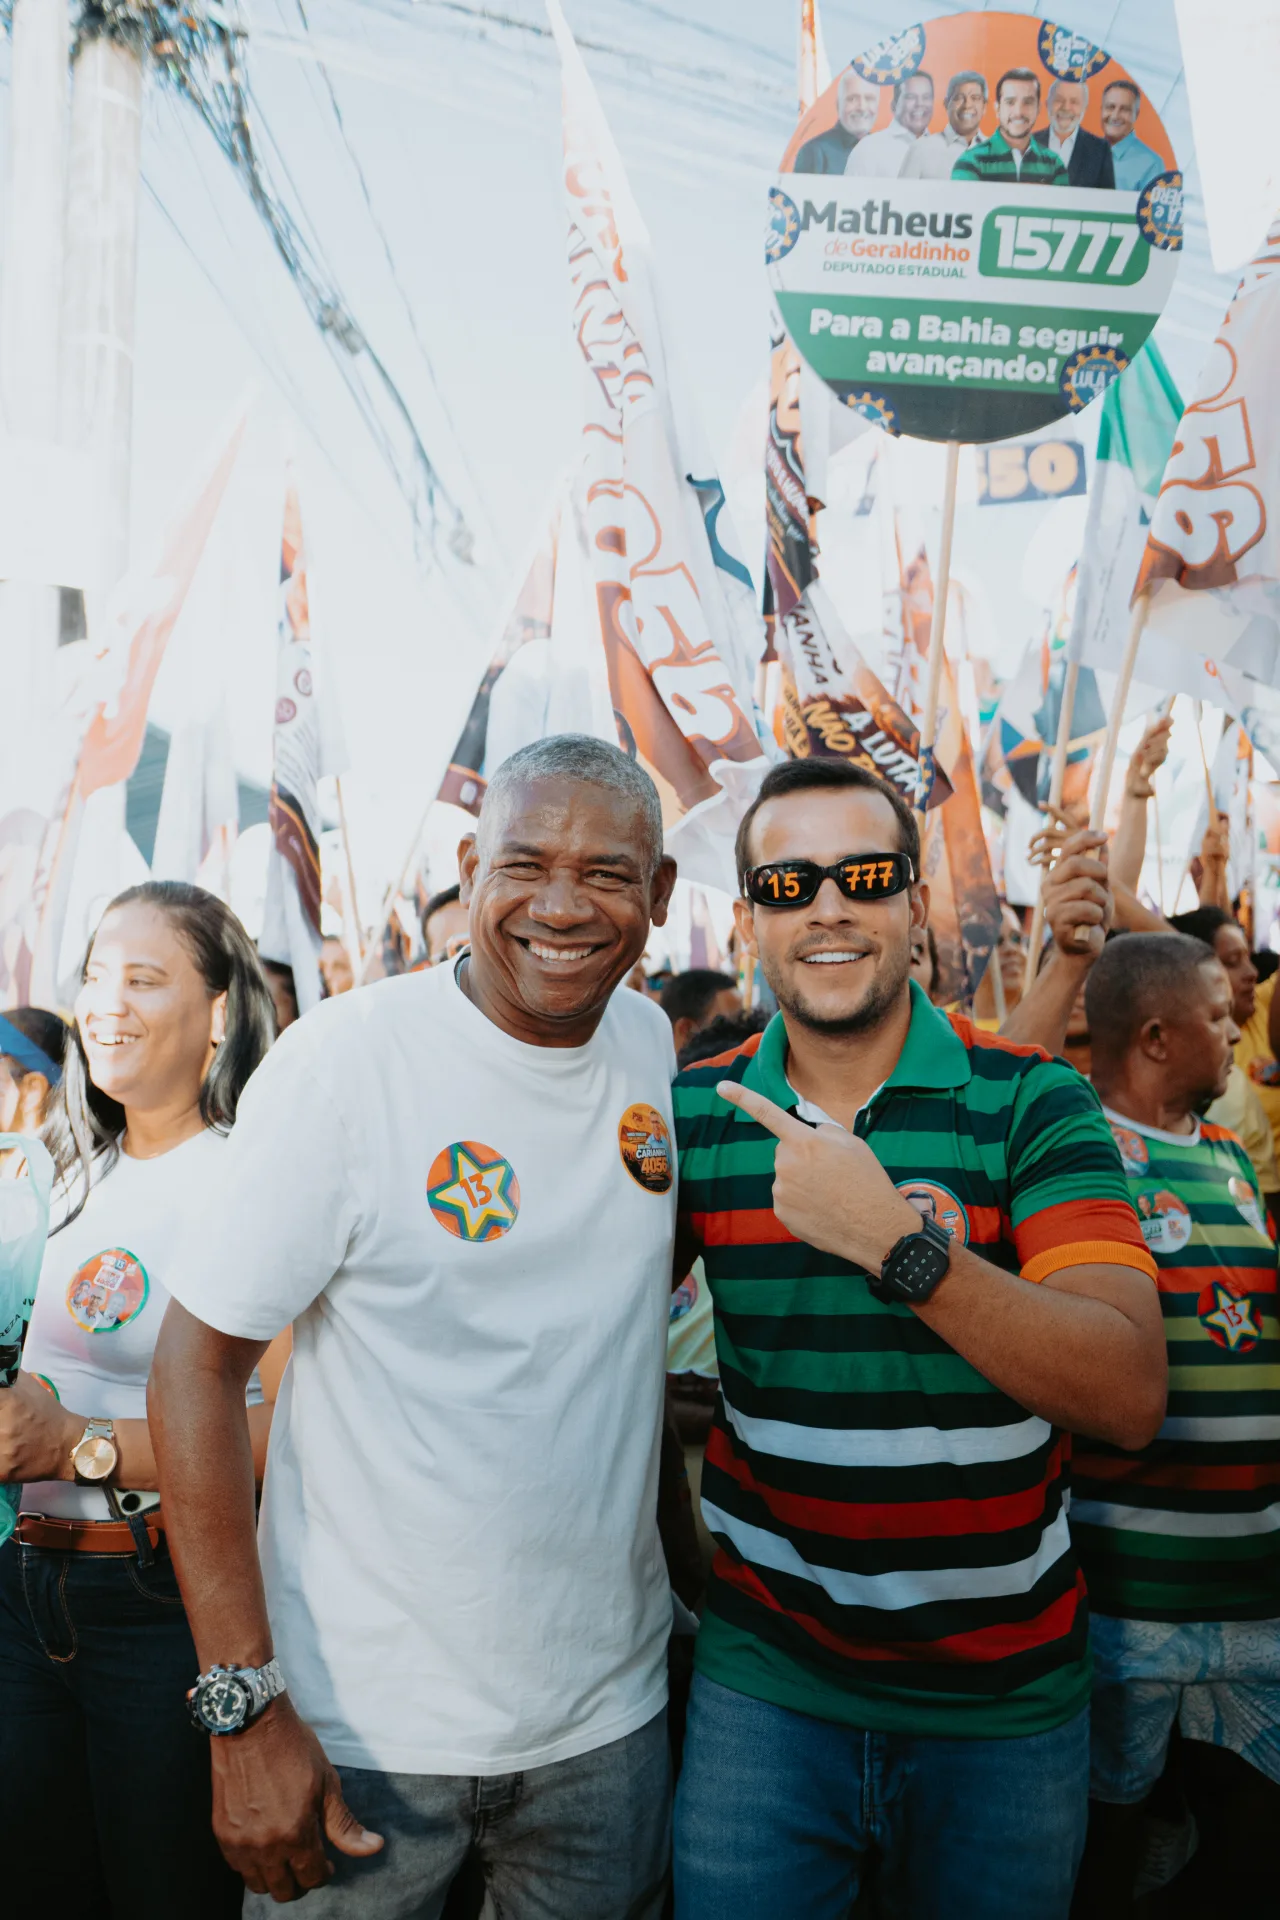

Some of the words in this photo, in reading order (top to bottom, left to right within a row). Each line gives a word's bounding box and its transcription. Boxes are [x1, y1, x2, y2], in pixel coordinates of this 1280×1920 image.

[802, 199, 973, 239] Matheus
[824, 236, 848, 256] de
[851, 239, 971, 262] Geraldinho
[994, 214, 1141, 276] 15777
[823, 261, 895, 276] DEPUTADO
[898, 264, 968, 279] ESTADUAL
[809, 307, 883, 339] Para
[889, 317, 911, 341] a
[917, 314, 1011, 346] Bahia
[1017, 325, 1124, 356] seguir
[866, 350, 1058, 384] avançando!
[861, 730, 926, 794] LUTA
[767, 872, 800, 899] 15
[844, 861, 895, 892] 777
[458, 1173, 492, 1209] 13
[1220, 1303, 1243, 1328] 13
